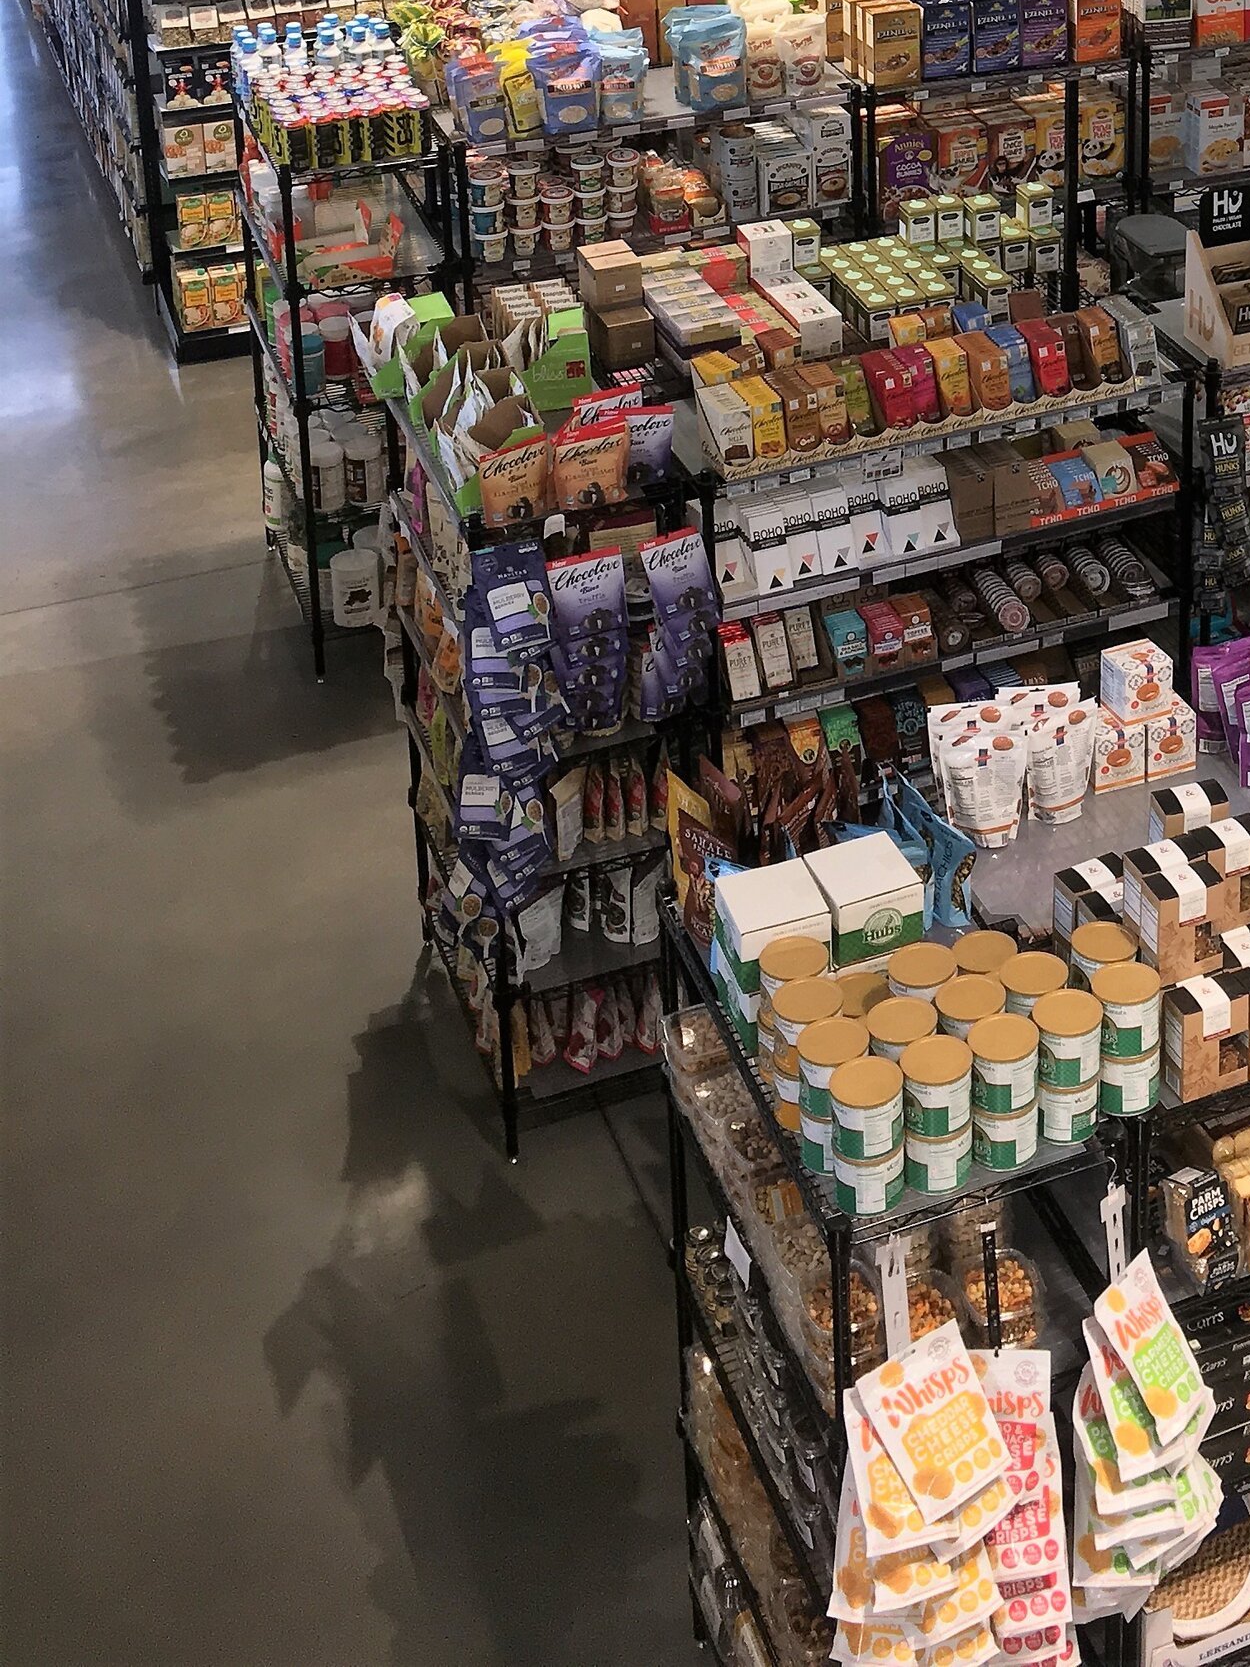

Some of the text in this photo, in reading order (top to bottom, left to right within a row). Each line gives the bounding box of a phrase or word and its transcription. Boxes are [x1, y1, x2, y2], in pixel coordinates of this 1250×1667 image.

[1213, 221, 1242, 233] CHOCOLATE
[558, 437, 625, 465] Chocolove
[482, 445, 548, 480] Chocolove
[1215, 461, 1241, 474] HUNKS
[1037, 479, 1058, 491] TCHO
[1073, 471, 1095, 483] TCHO
[918, 482, 946, 496] BOHO
[1151, 485, 1174, 497] TCHO
[847, 492, 876, 507] BOHO
[888, 492, 917, 507] BOHO
[1114, 495, 1137, 507] TCHO
[817, 506, 846, 521] BOHO
[1077, 505, 1100, 517] TCHO
[1220, 501, 1247, 520] HUNKS
[713, 520, 735, 533] OHO
[783, 512, 812, 527] BOHO
[1040, 514, 1062, 526] TCHO
[753, 526, 783, 542] BOHO
[649, 533, 702, 570] Chocolove
[555, 560, 620, 591] Chocolove
[684, 827, 732, 860] SAHALE
[863, 923, 902, 944] Hubs
[1192, 1186, 1222, 1210] PARM
[1190, 1196, 1226, 1222] CRISPS
[874, 1356, 970, 1430] Whisps
[907, 1395, 970, 1448] CHEDDAR
[914, 1409, 978, 1462] CHEESE
[933, 1428, 979, 1467] CRISPS
[999, 1578, 1044, 1596] RISPS
